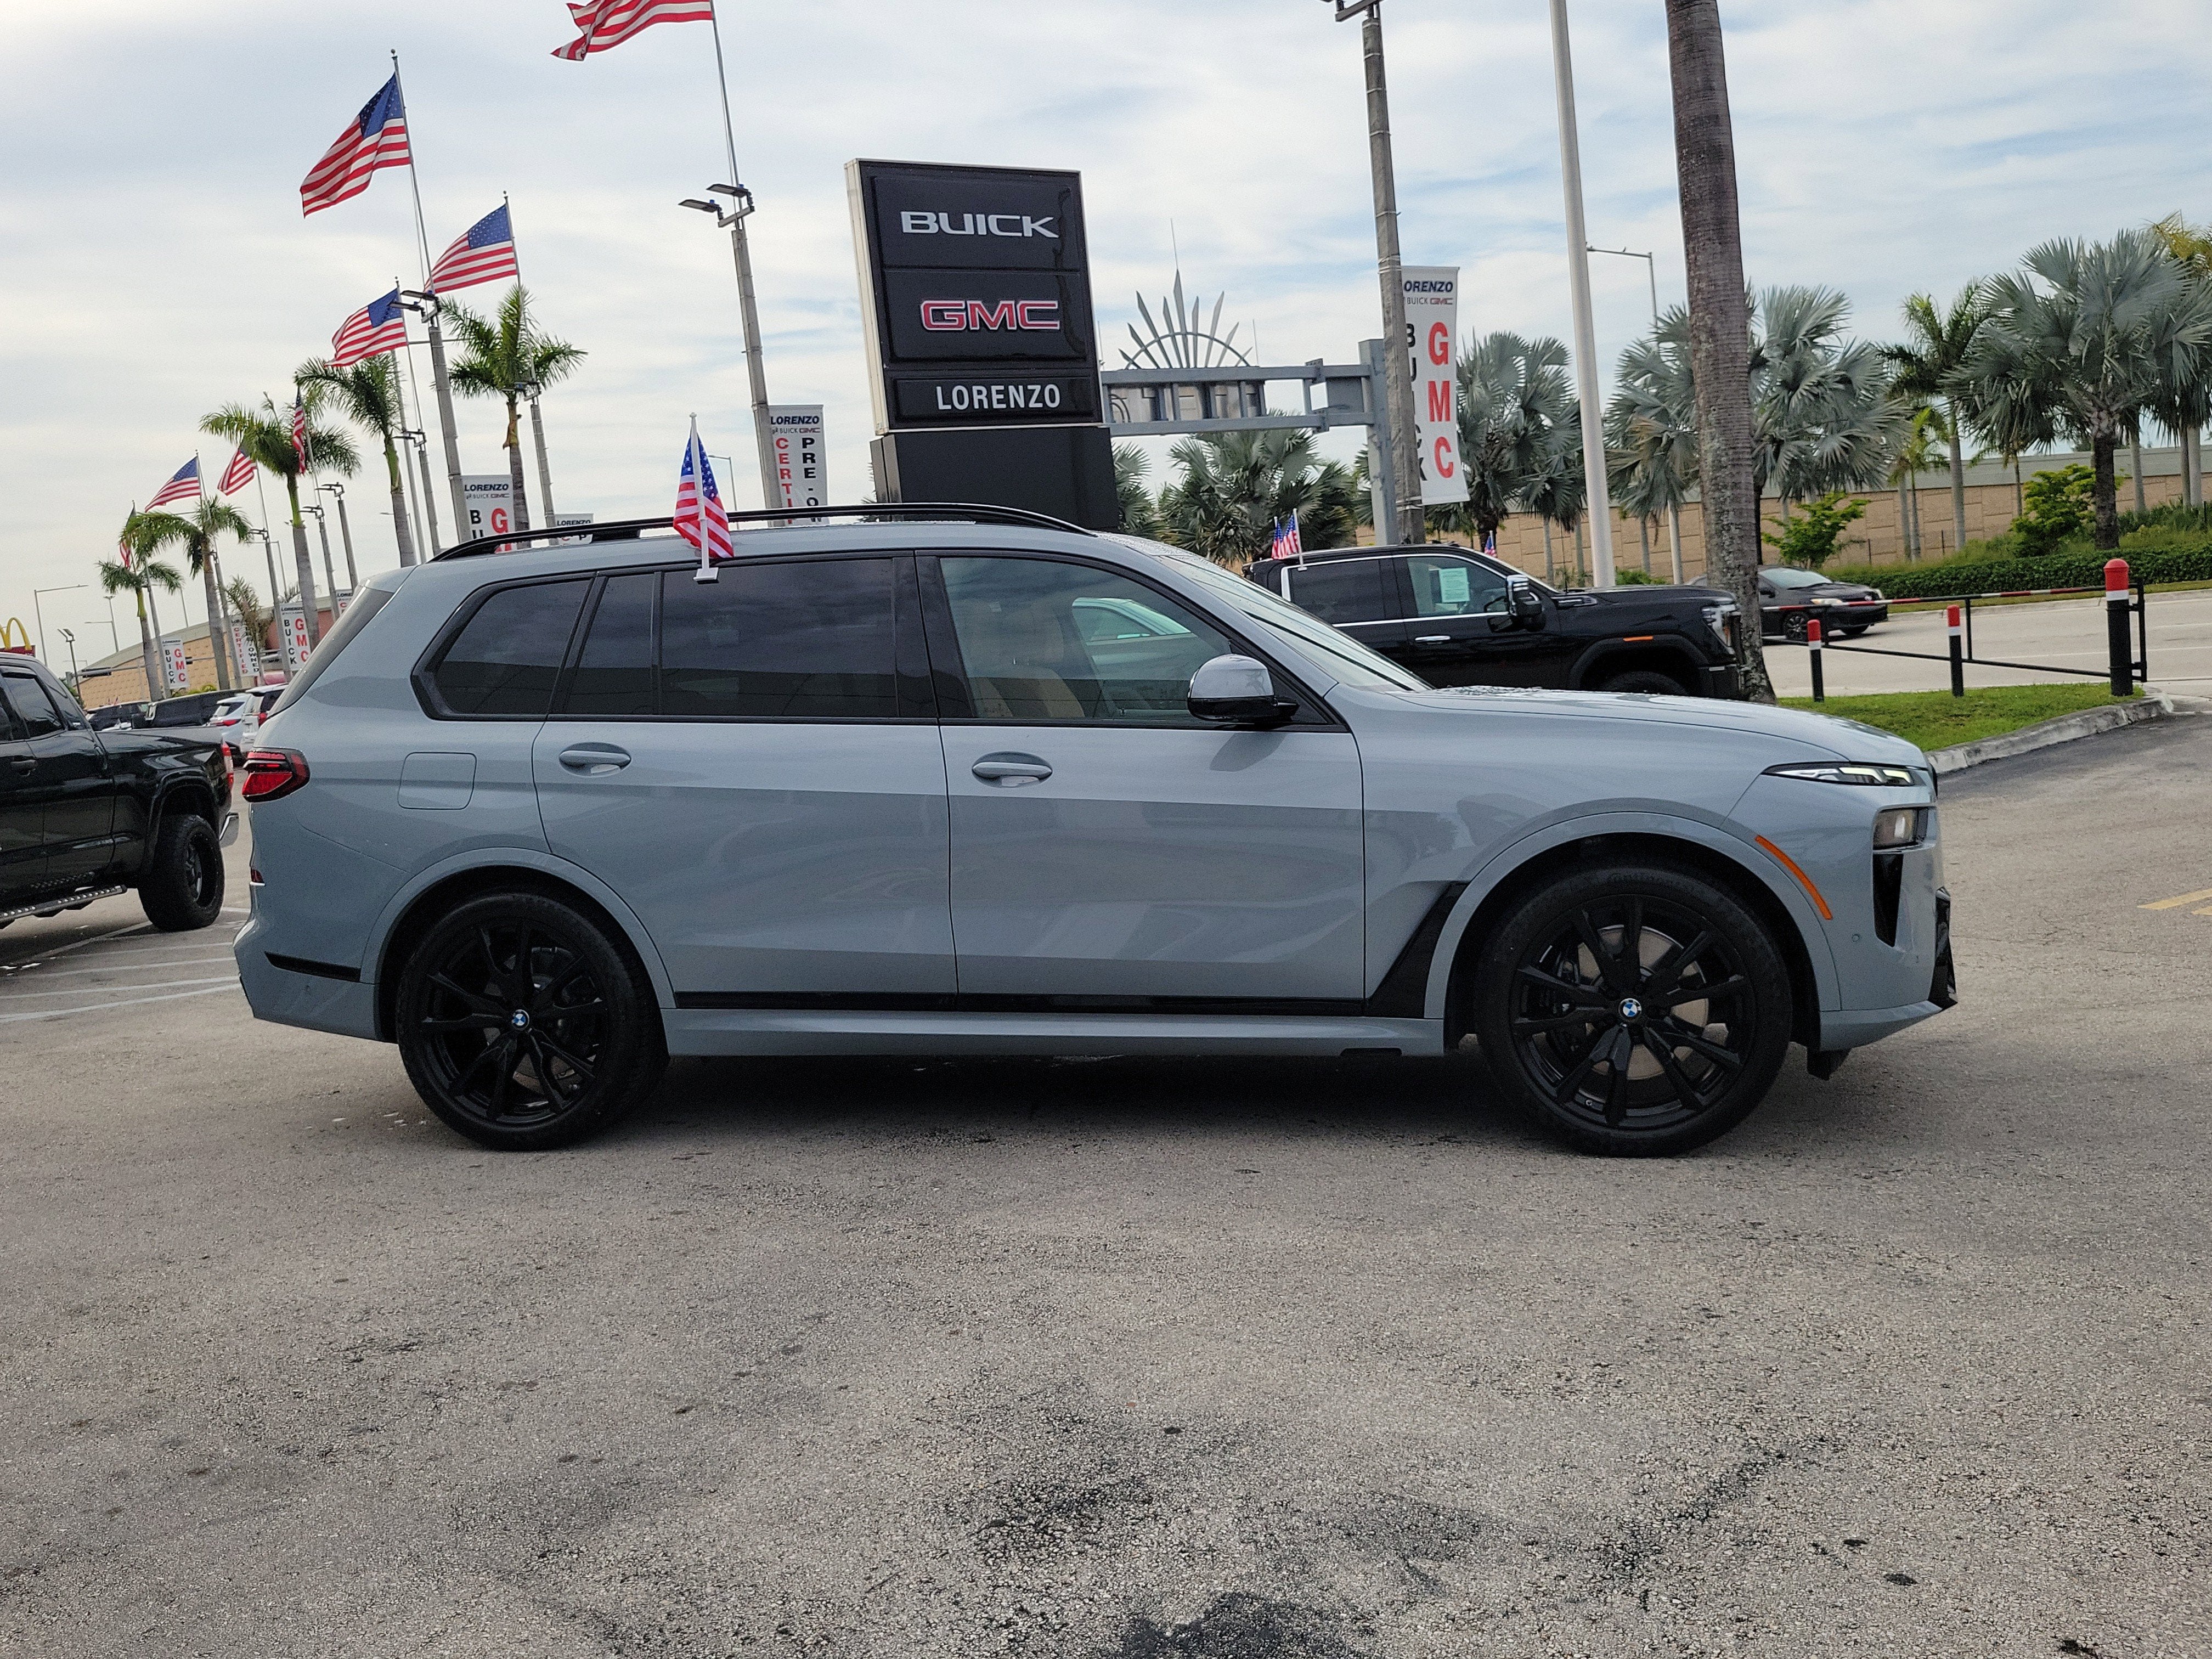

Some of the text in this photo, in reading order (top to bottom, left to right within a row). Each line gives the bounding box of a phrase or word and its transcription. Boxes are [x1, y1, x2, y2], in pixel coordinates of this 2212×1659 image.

[900, 211, 1059, 238] BUICK
[1404, 280, 1453, 292] ORENZO
[920, 299, 1060, 331] GMC
[936, 384, 1060, 410] LORENZO
[1427, 322, 1453, 478] GMC
[770, 415, 820, 425] LORENZO
[284, 619, 297, 664] BUICK
[295, 618, 308, 662] GMC
[165, 650, 176, 684] BUICK
[174, 648, 187, 682] GMC
